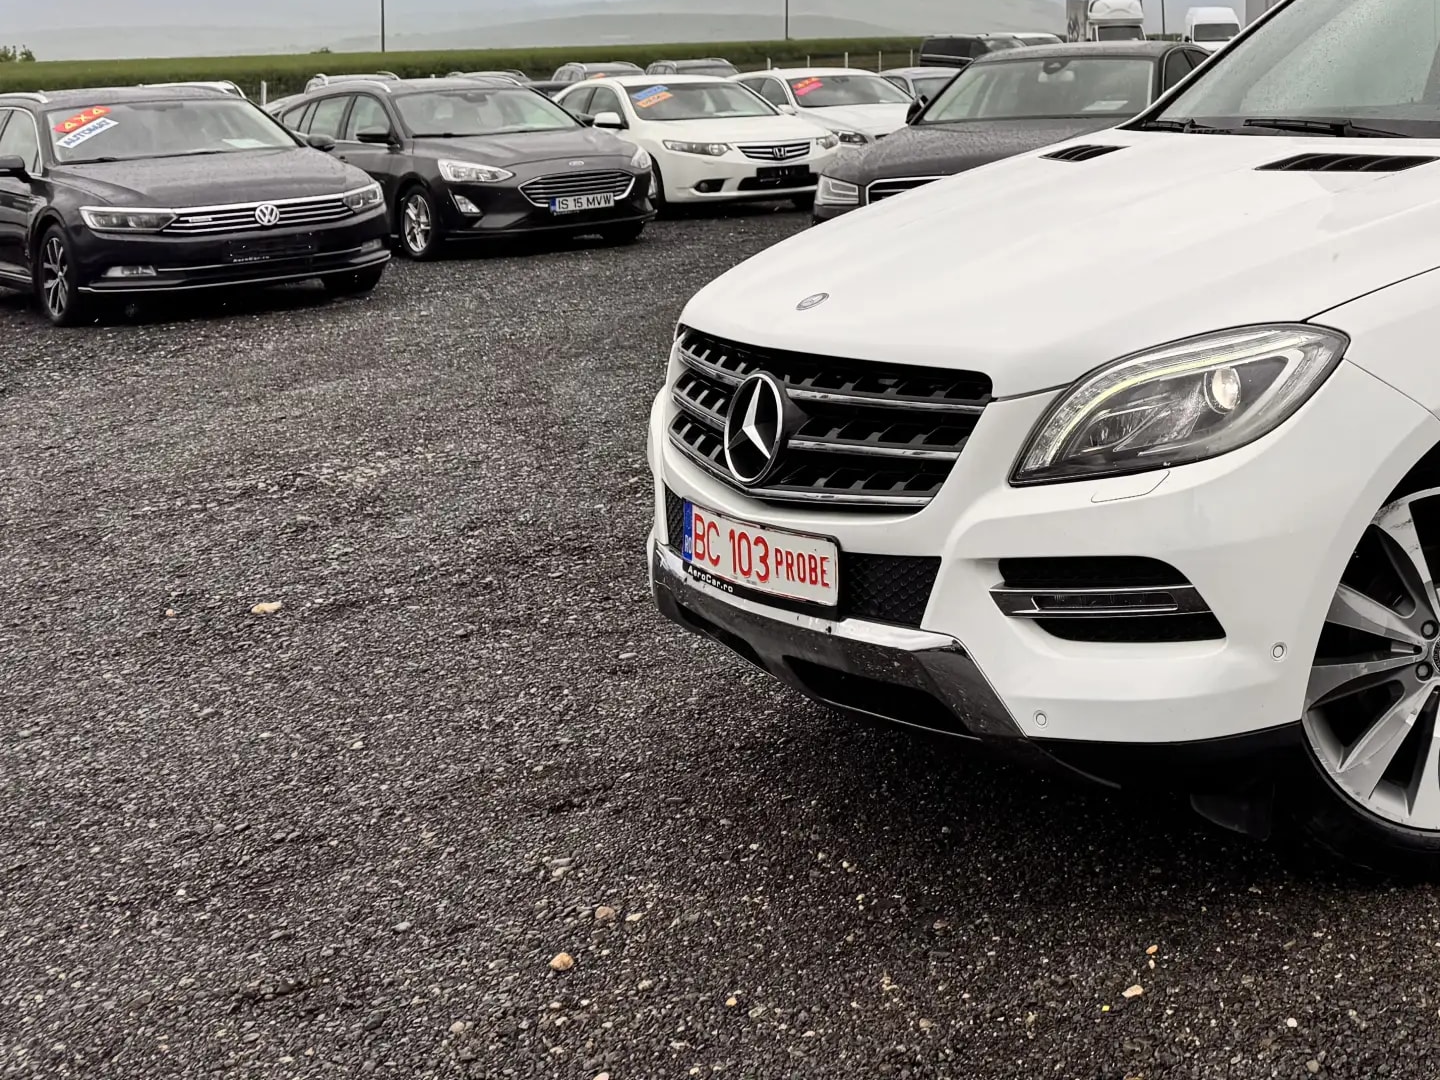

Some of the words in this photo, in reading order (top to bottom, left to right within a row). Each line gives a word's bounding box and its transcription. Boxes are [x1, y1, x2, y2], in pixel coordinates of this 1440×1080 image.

[63, 119, 112, 146] AUTOMAT
[558, 199, 569, 210] IS
[573, 197, 583, 209] 15
[586, 193, 612, 208] MVW
[694, 512, 721, 568] BC
[728, 528, 770, 584] 103
[774, 547, 831, 589] PROBE
[687, 564, 734, 593] AeroCar.ro
